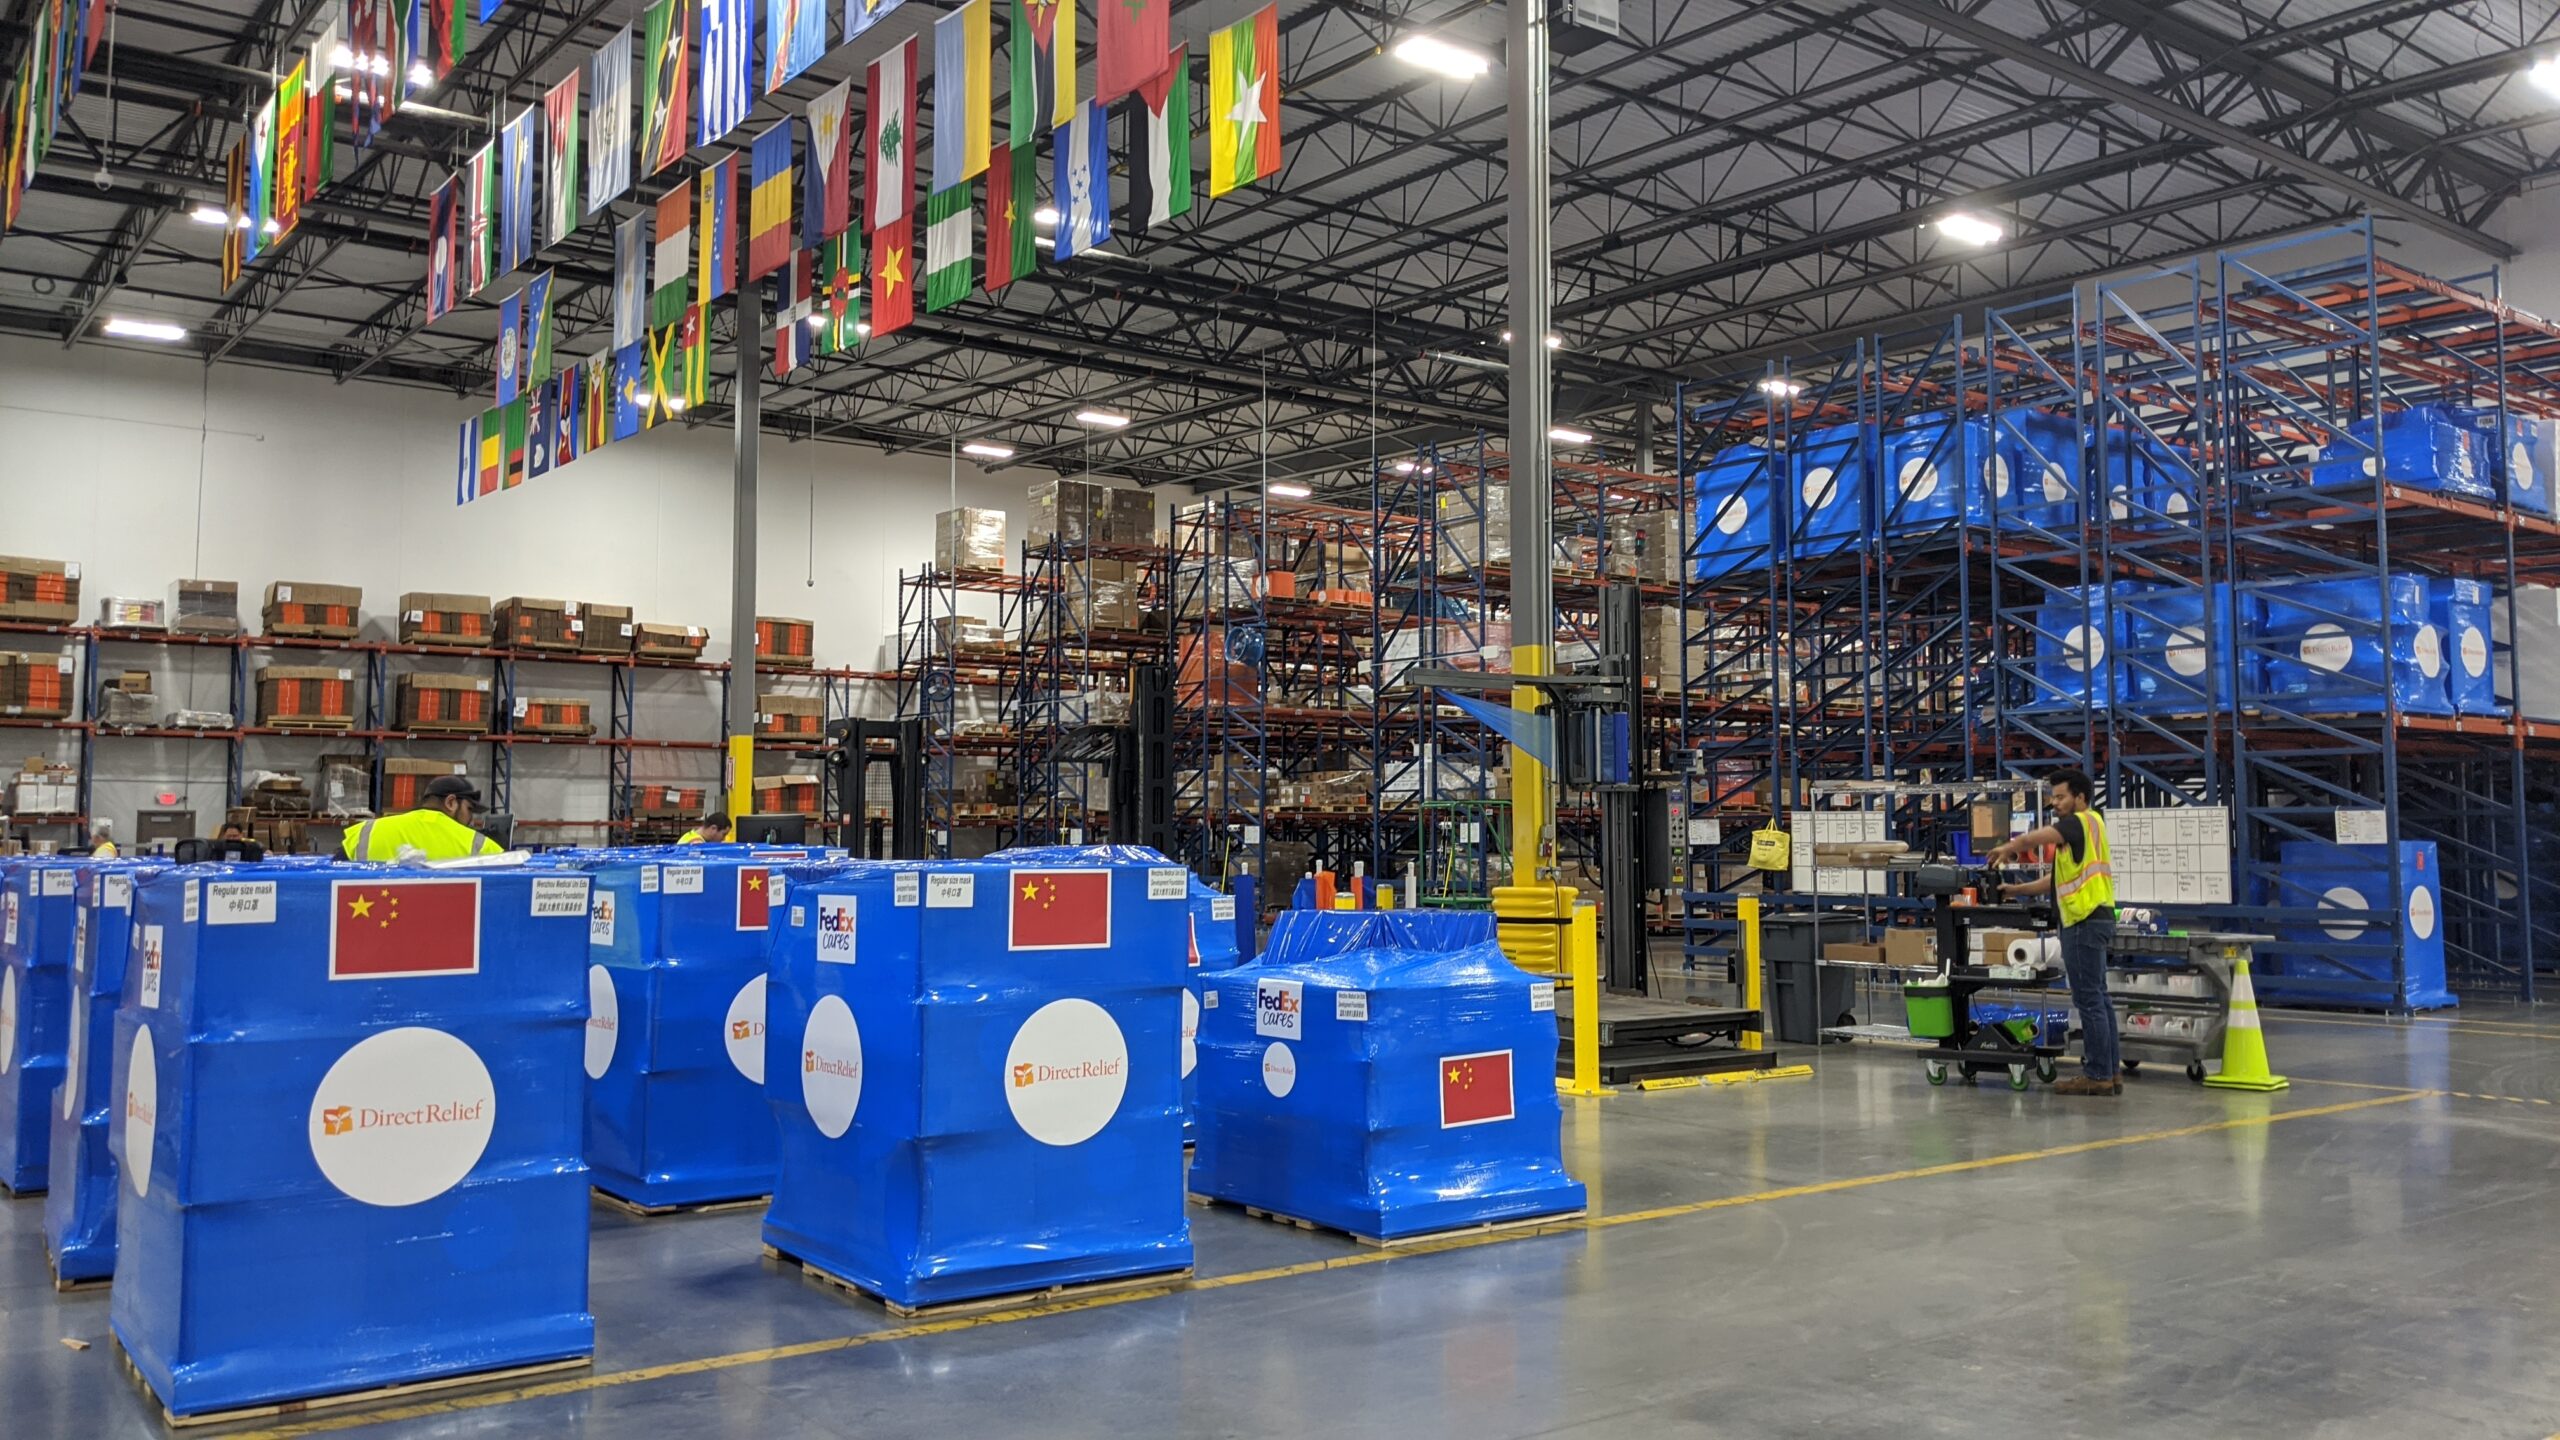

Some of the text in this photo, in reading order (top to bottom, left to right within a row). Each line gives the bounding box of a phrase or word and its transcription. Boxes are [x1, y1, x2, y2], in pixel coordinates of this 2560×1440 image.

[109, 876, 128, 887] Regula
[930, 875, 971, 886] Regular size mask
[213, 884, 273, 898] Regular size mask
[229, 899, 259, 912] 中号口罩
[819, 907, 854, 932] FedEx
[822, 932, 850, 951] cares
[1258, 988, 1299, 1013] FedEx
[1262, 1011, 1294, 1028] cares
